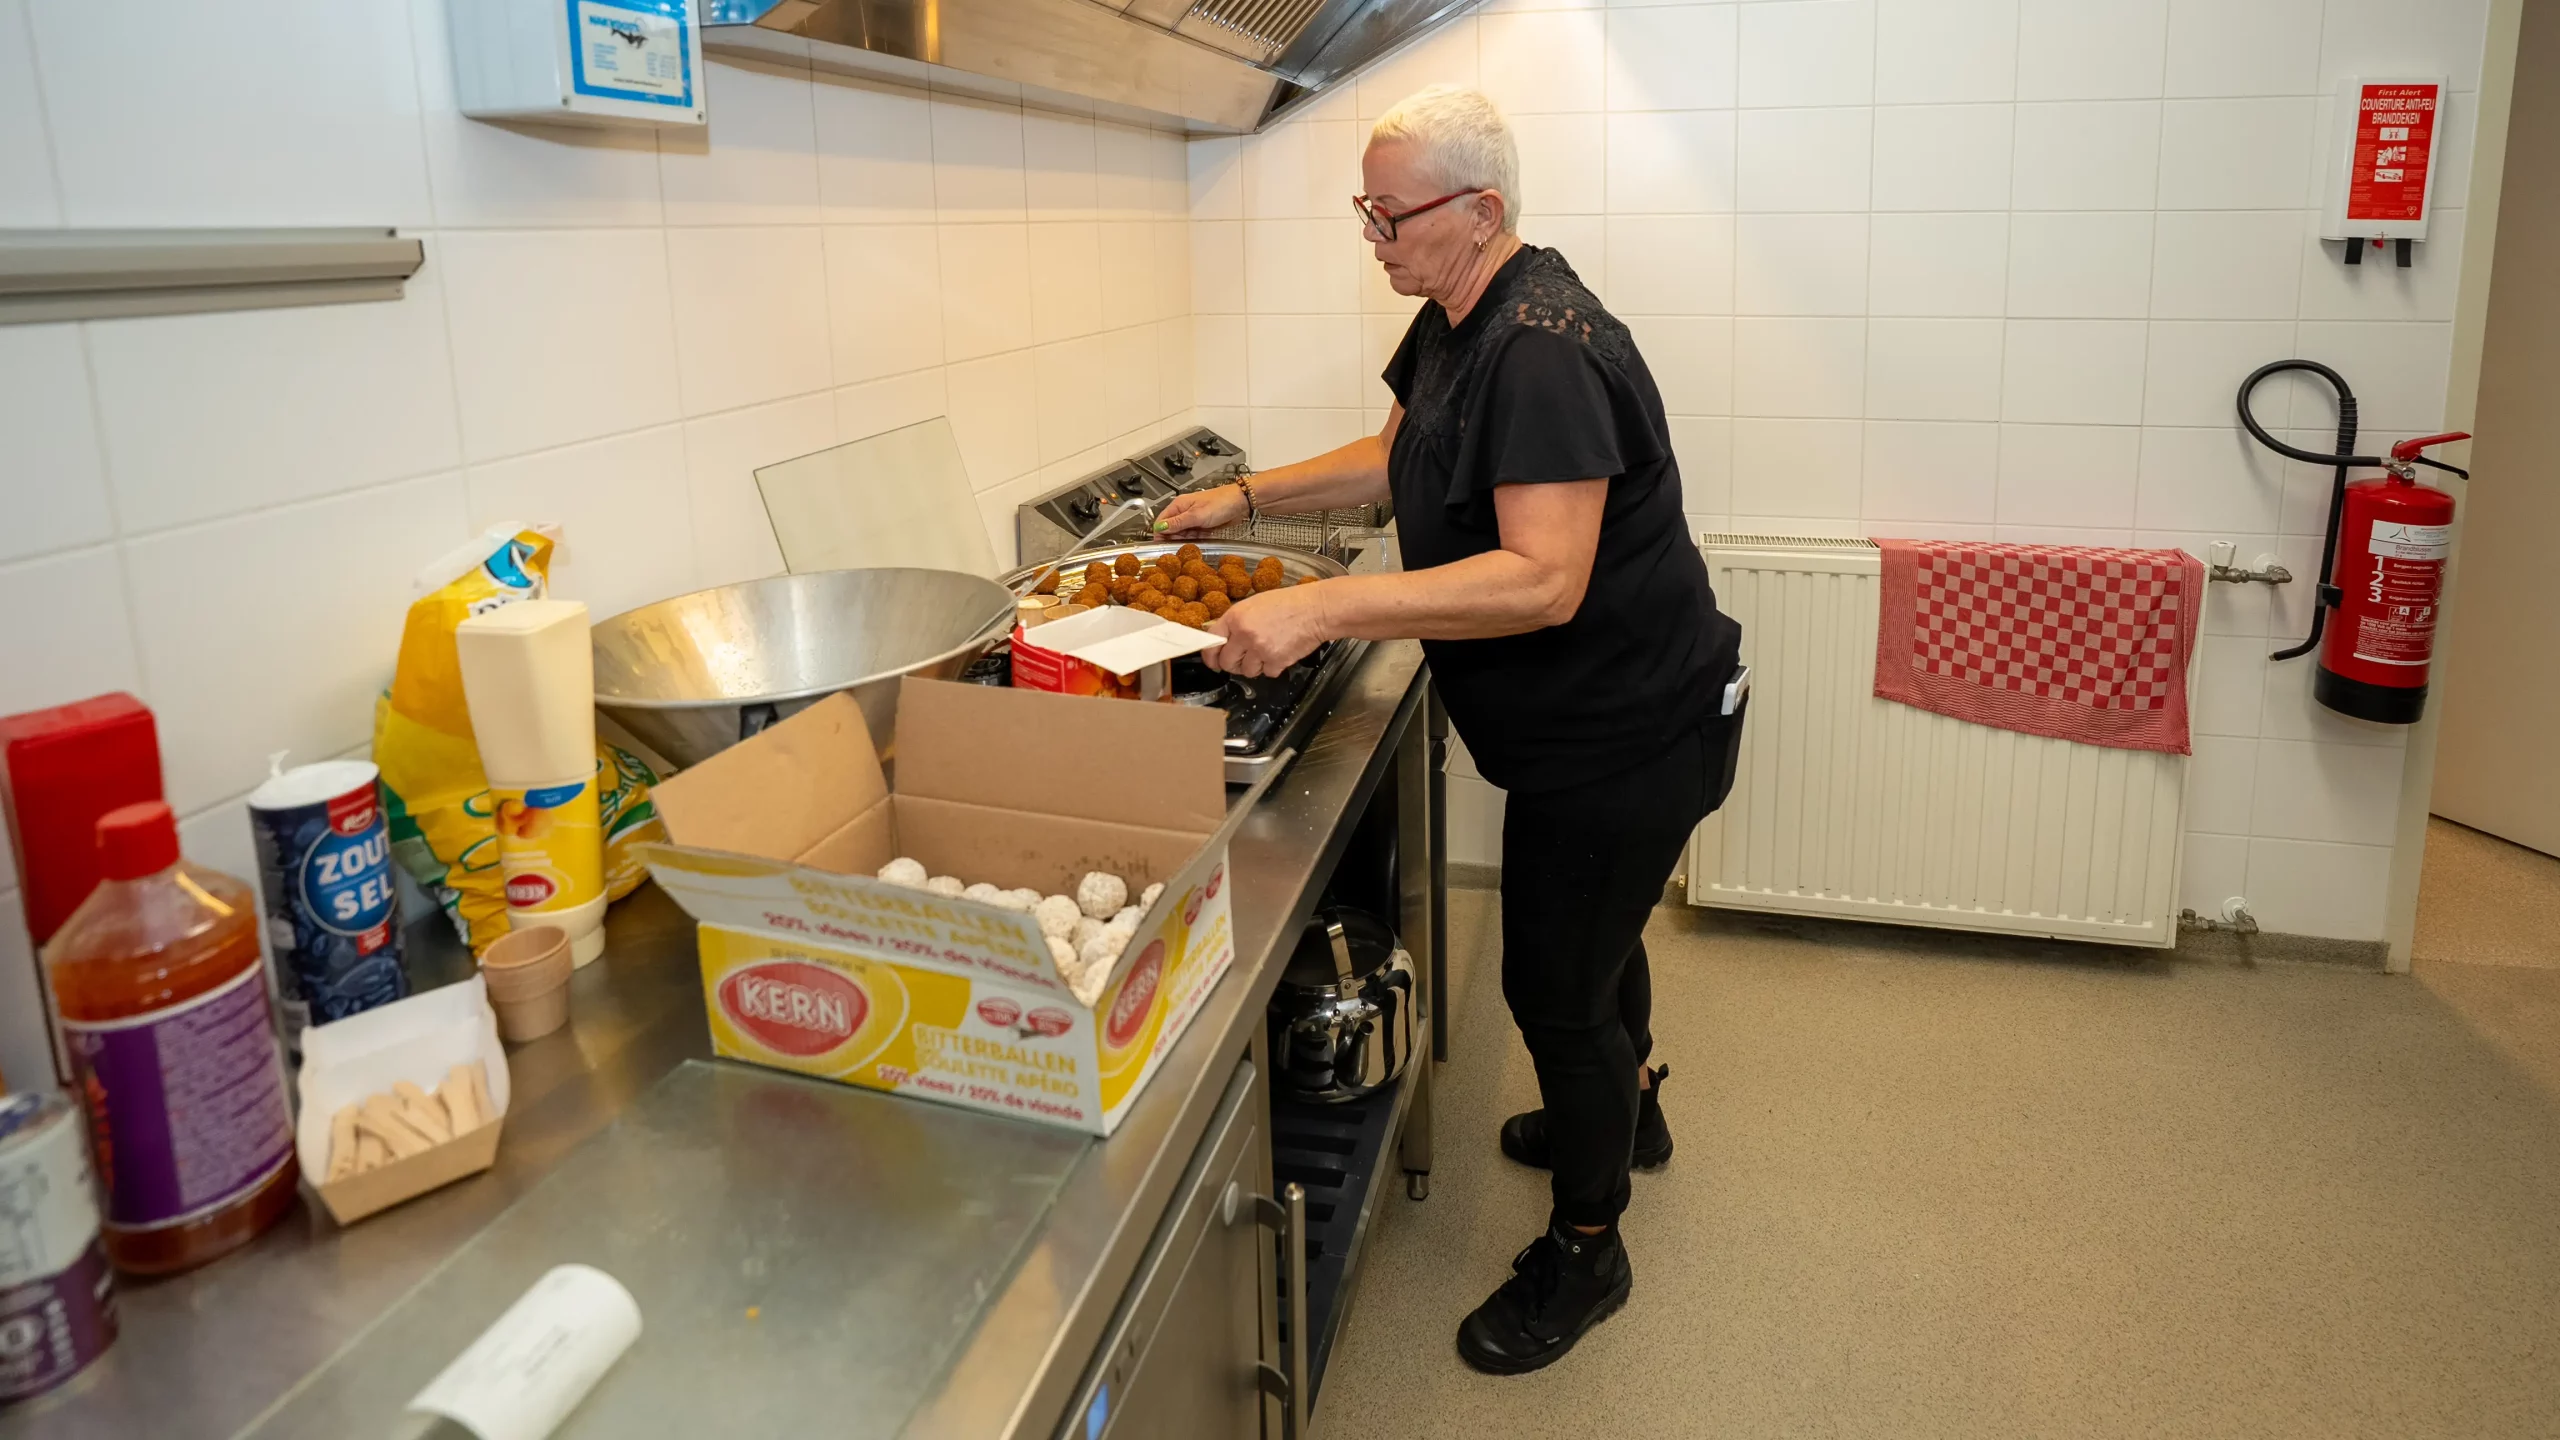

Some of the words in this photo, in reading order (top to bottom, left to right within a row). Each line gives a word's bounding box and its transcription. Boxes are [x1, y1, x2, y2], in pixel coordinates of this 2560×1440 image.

[2361, 98, 2405, 110] COUVERTURE
[2405, 98, 2436, 110] ANTI-FEU
[2372, 112, 2420, 124] BRANDDEKEN
[2375, 555, 2384, 571] 1
[2369, 571, 2384, 588] 2
[2368, 586, 2382, 602] 3
[314, 827, 390, 886] ZOUT
[333, 873, 394, 921] SEL
[506, 883, 547, 900] KERN
[1113, 957, 1159, 1034] KERN
[738, 976, 849, 1034] KERN
[913, 1024, 1078, 1076] BITTERBALLEN
